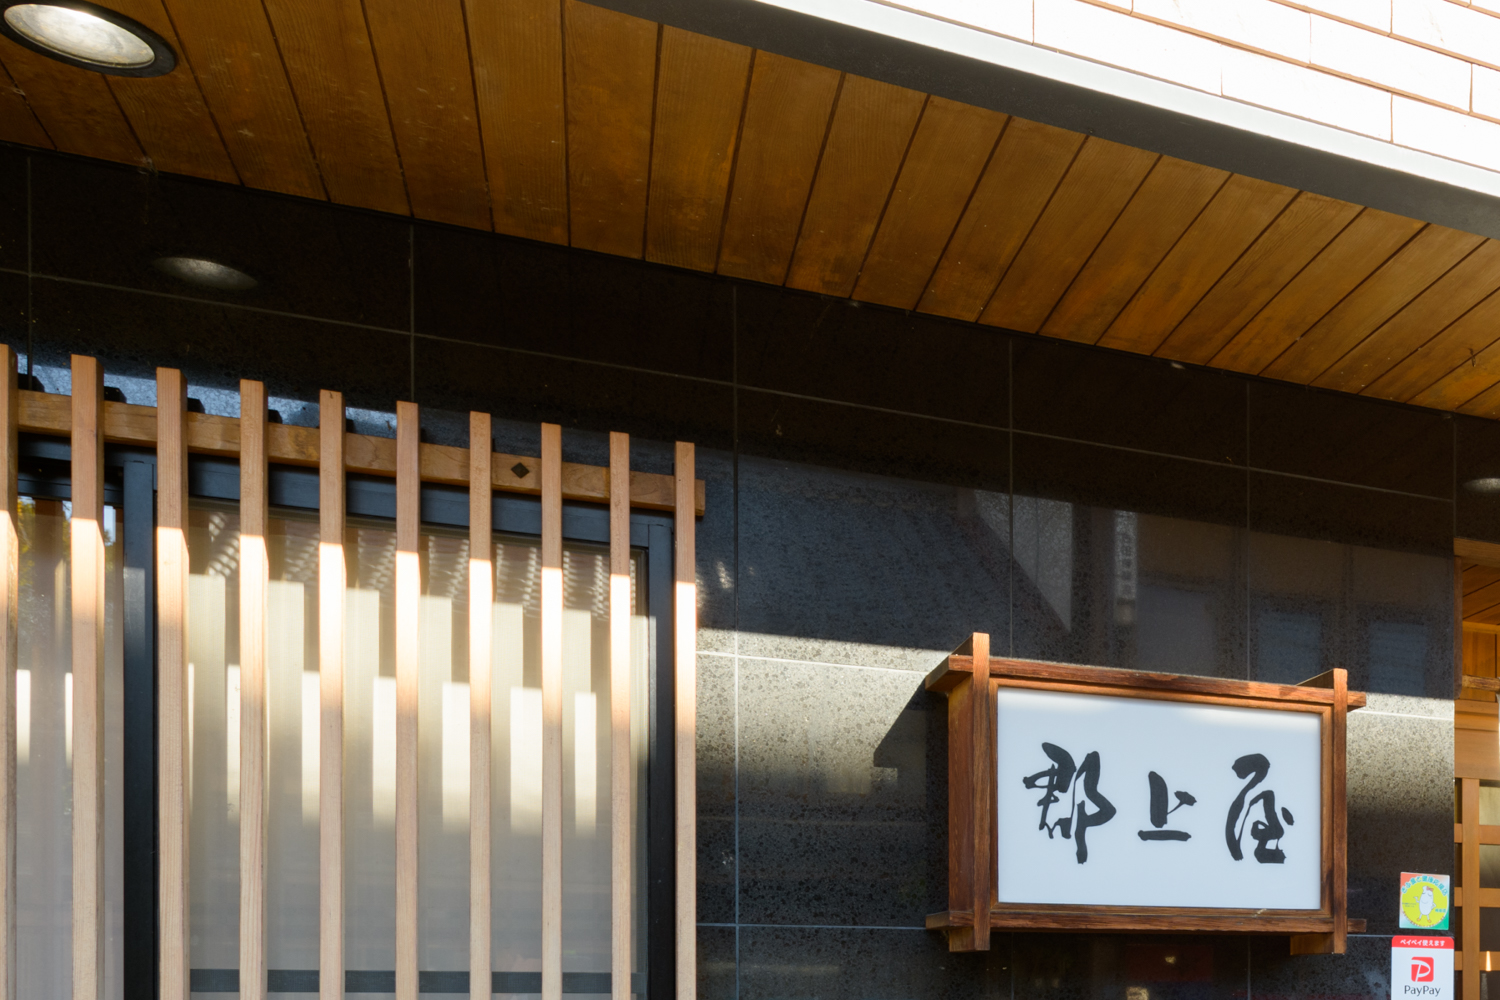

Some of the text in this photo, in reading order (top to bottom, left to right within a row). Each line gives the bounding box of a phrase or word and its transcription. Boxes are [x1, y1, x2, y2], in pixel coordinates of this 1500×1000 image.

[1022, 741, 1295, 865] 郡上屋
[1400, 939, 1446, 947] ペイペイ使えます
[1404, 985, 1441, 997] PayPay
